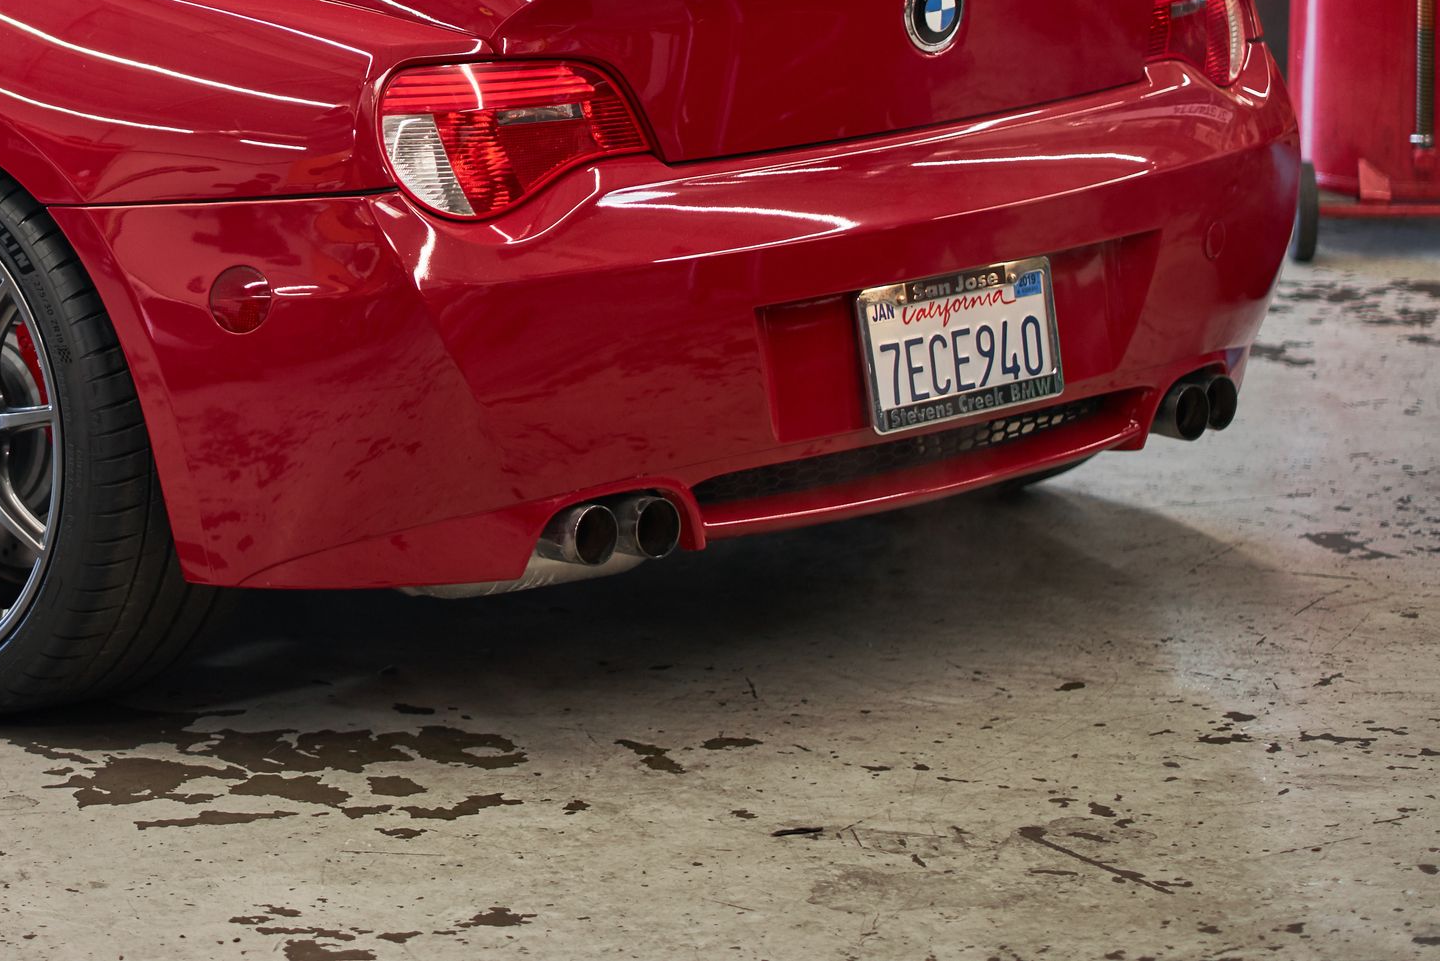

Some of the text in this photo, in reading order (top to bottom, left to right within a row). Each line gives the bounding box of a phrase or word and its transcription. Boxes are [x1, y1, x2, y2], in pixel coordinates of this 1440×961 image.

[912, 271, 999, 301] San Jose
[1018, 273, 1036, 288] 2019
[872, 304, 894, 322] JAN
[902, 289, 1016, 327] California
[880, 315, 1043, 406] 7ECE940
[890, 378, 1051, 427] Stevens Creek BMW
